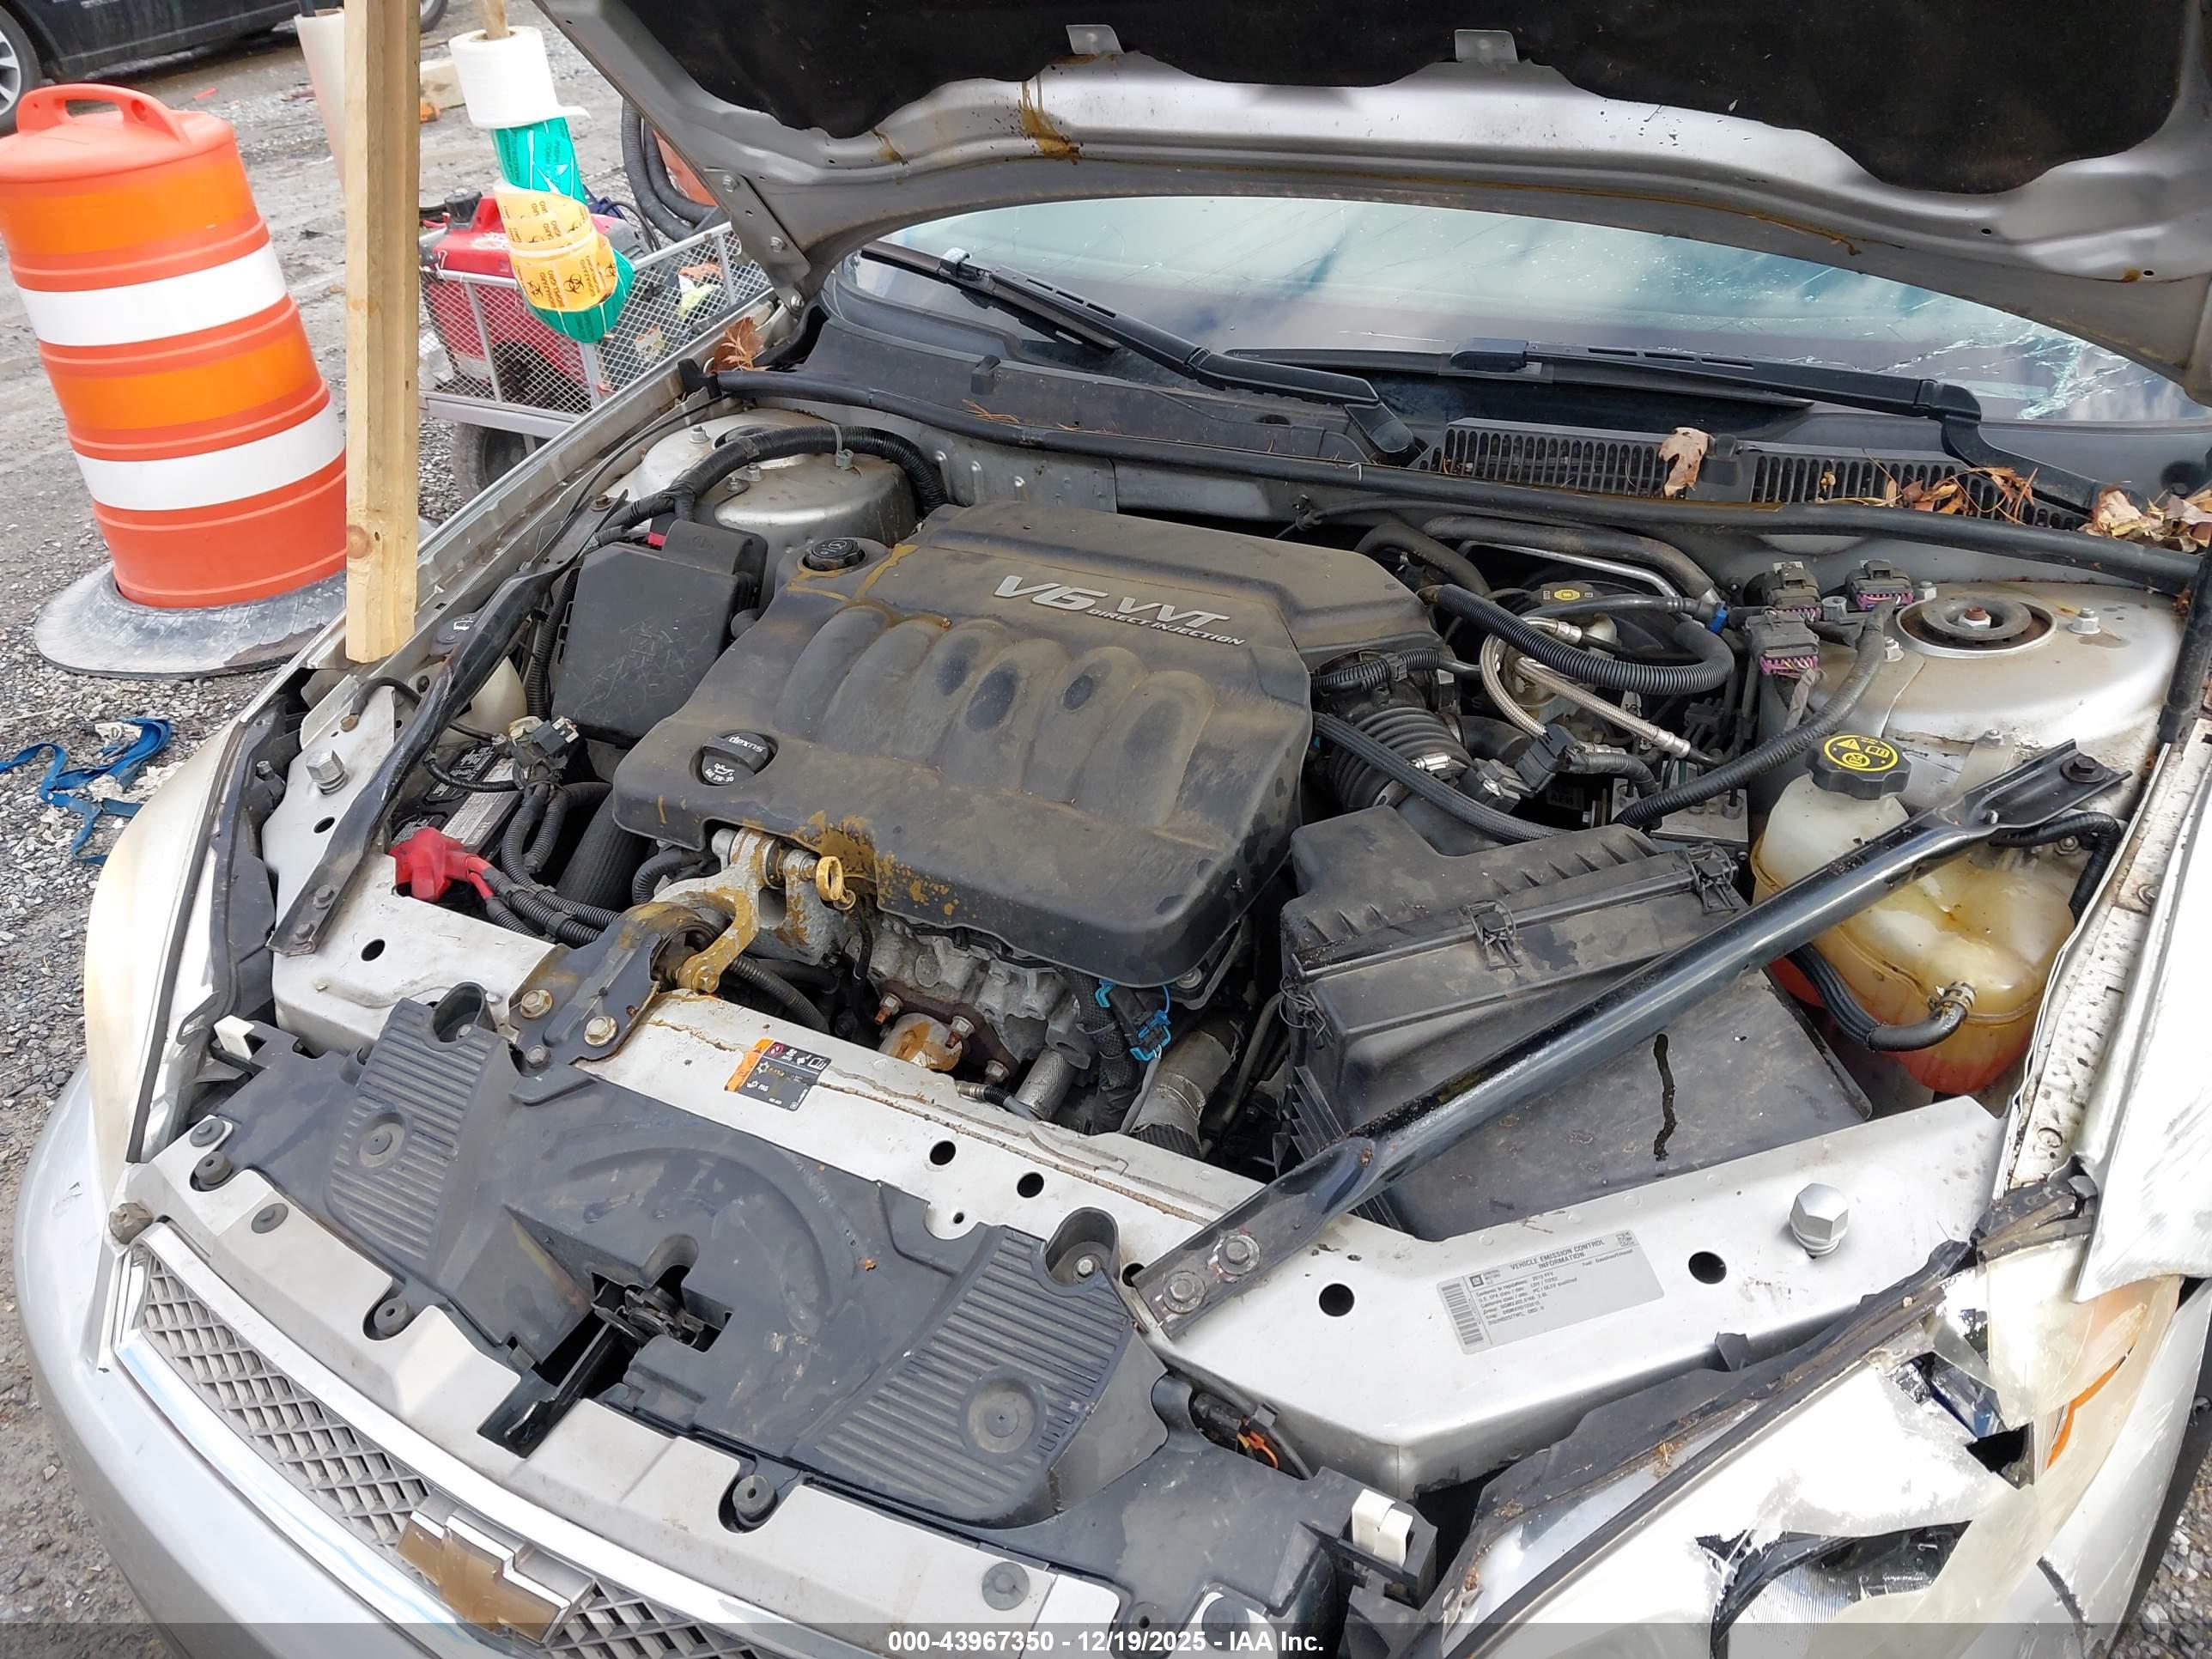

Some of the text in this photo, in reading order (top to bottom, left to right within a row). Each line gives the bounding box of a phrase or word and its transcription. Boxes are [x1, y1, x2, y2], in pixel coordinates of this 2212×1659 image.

[994, 575, 1230, 629] V6 VVT
[1085, 608, 1245, 646] DIRECT INJECTION
[1510, 1240, 1605, 1271] VEHICLE EMISSION CONTROL
[1539, 1252, 1585, 1270] INFORMATION
